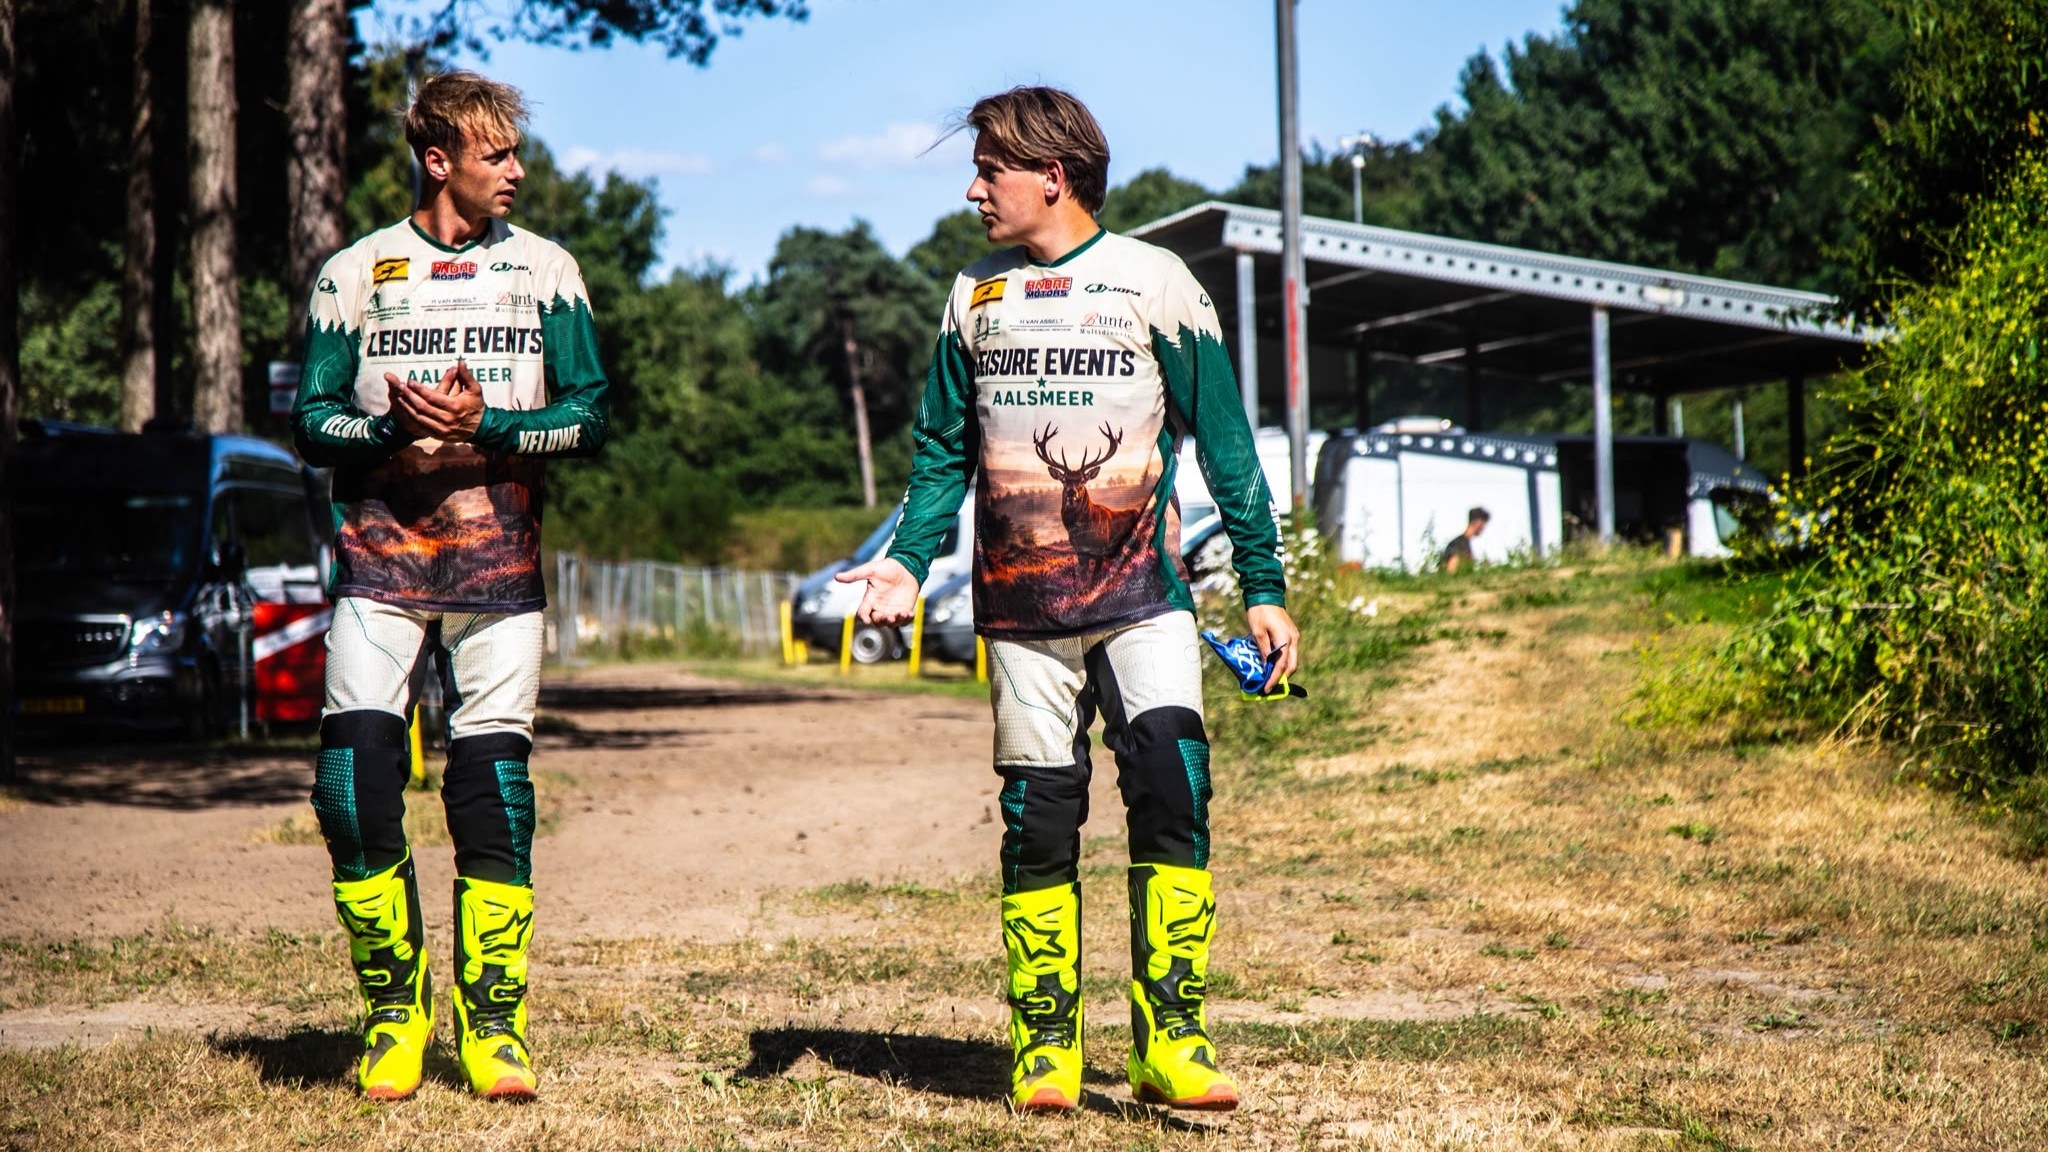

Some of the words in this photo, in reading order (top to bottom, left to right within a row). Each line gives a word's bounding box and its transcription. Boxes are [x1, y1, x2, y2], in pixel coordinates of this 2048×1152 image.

[432, 261, 477, 274] ANDRE
[431, 272, 476, 281] MOTORS
[1027, 277, 1072, 290] ANDRE
[1026, 289, 1068, 299] MOTORS
[1108, 286, 1141, 297] JOPA
[1080, 311, 1133, 330] Bunte
[367, 327, 457, 358] LEISURE
[463, 326, 543, 355] EVENTS
[976, 348, 1040, 377] EISURE
[1044, 348, 1135, 377] EVENTS
[407, 367, 513, 384] AALEER
[992, 390, 1094, 406] AALSMEER
